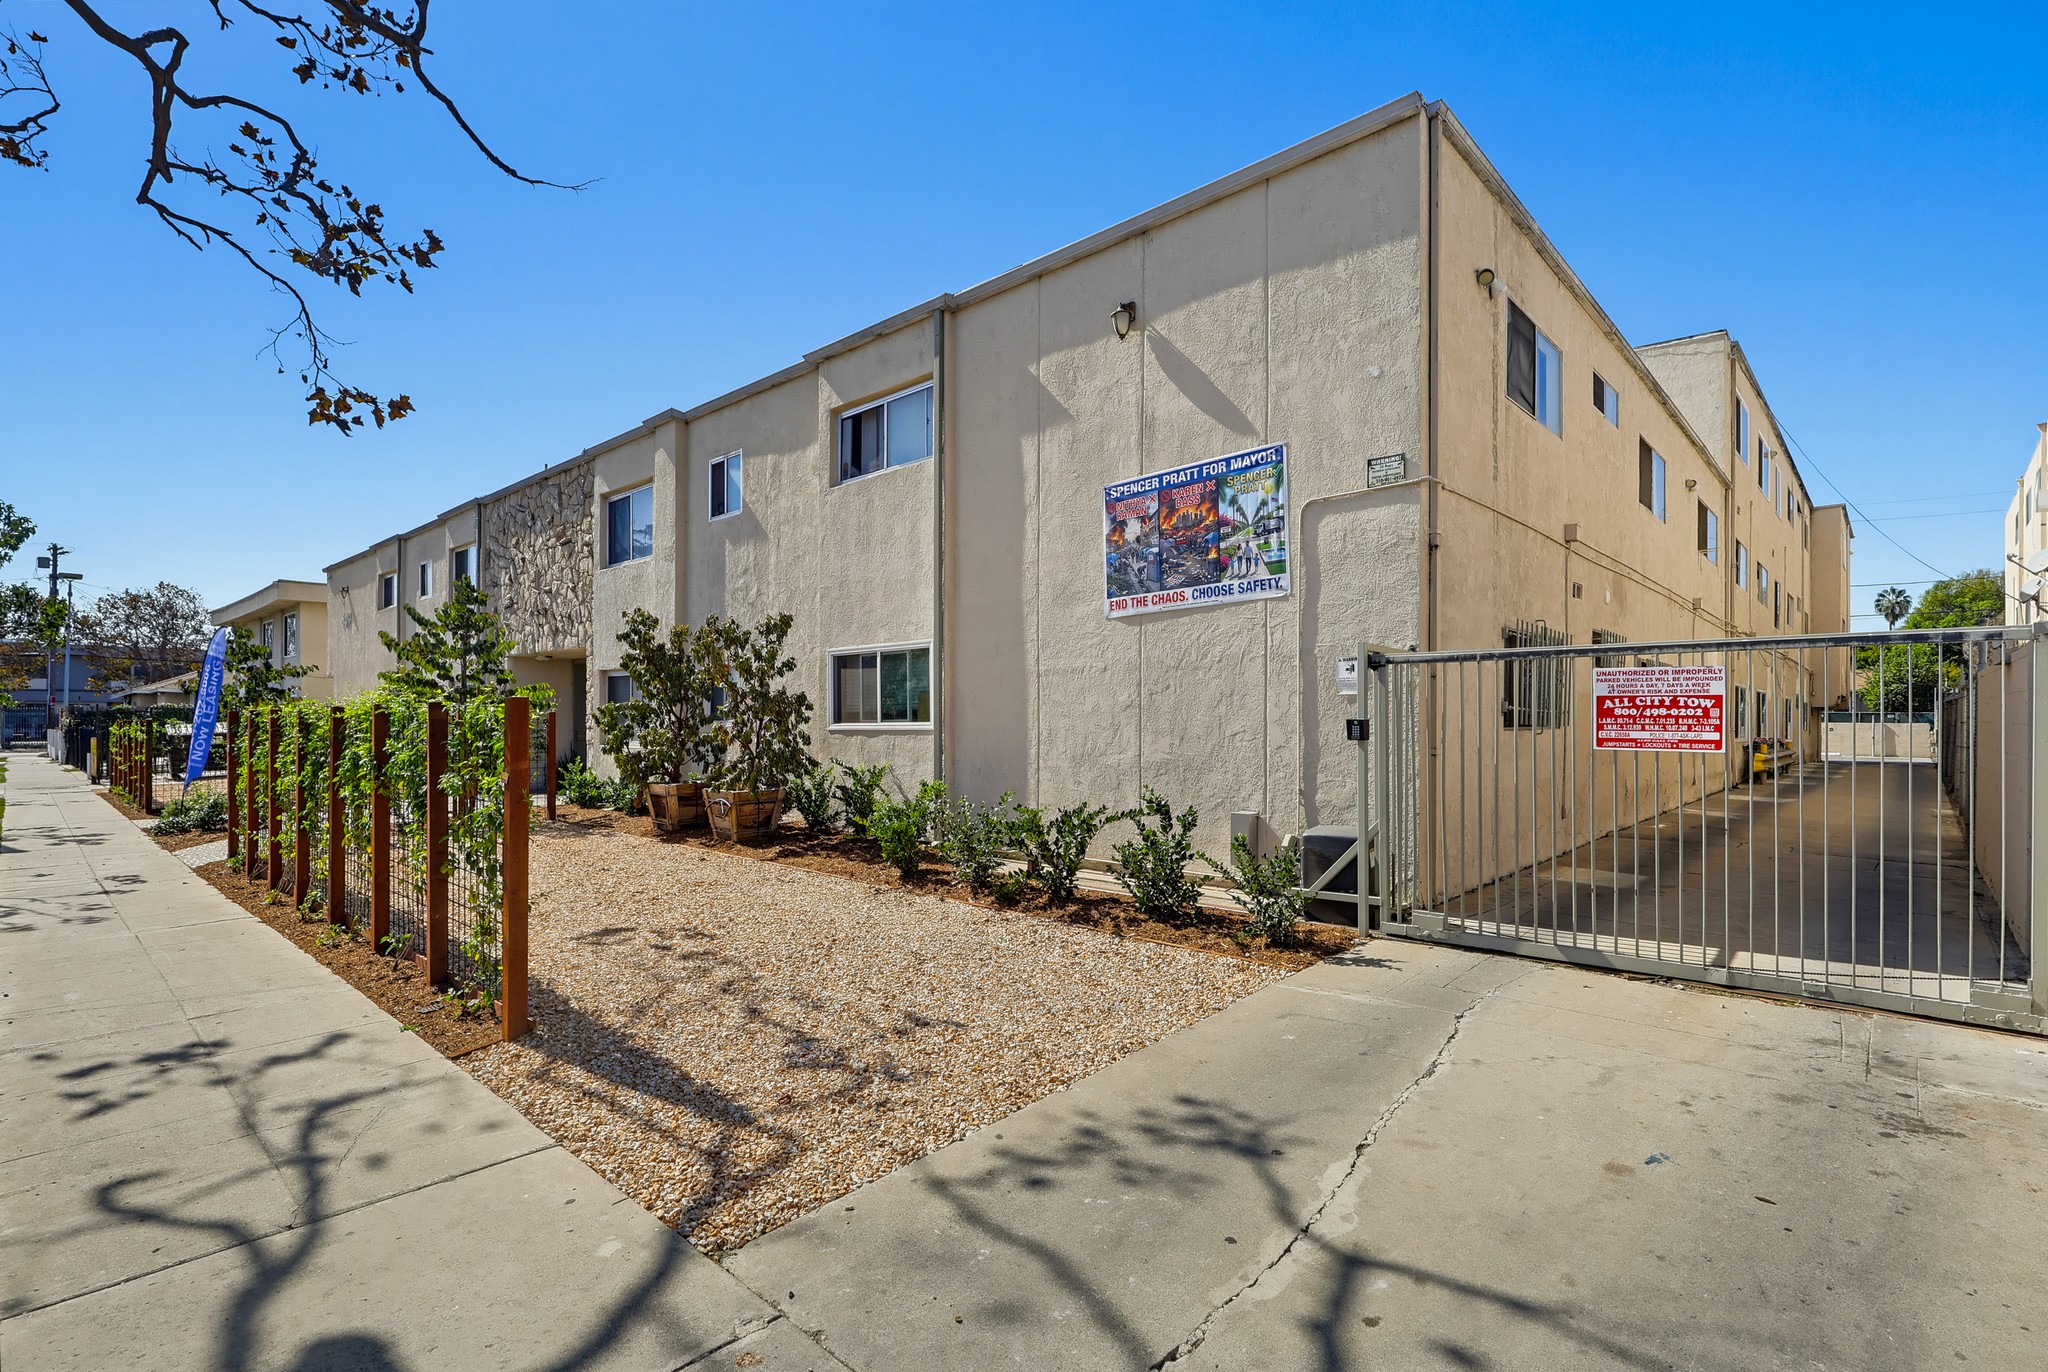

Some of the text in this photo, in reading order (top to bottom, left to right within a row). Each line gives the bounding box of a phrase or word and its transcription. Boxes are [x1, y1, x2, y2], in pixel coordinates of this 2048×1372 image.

[1110, 477, 1159, 498] SPENCER
[1163, 468, 1199, 487] PRATT
[1202, 461, 1226, 478] FOR
[1227, 468, 1273, 486] SPENCER
[1172, 482, 1204, 500] KAREN
[1234, 479, 1266, 496] PRATT
[1116, 496, 1146, 512] NITHYA
[1176, 494, 1201, 508] BASS
[1116, 506, 1148, 522] RAMAN
[1110, 598, 1128, 611] END
[1130, 596, 1148, 608] THE
[1152, 590, 1188, 606] CHAOS.
[1192, 584, 1234, 600] CHOOSE
[1238, 576, 1283, 594] SAFETY.
[1596, 669, 1656, 677] UNAUTHORIZED
[1604, 696, 1716, 708] ALL CITY TOW
[192, 726, 209, 761] NOW
[202, 660, 222, 723] LEASING
[1614, 708, 1704, 717] 800/498-0202
